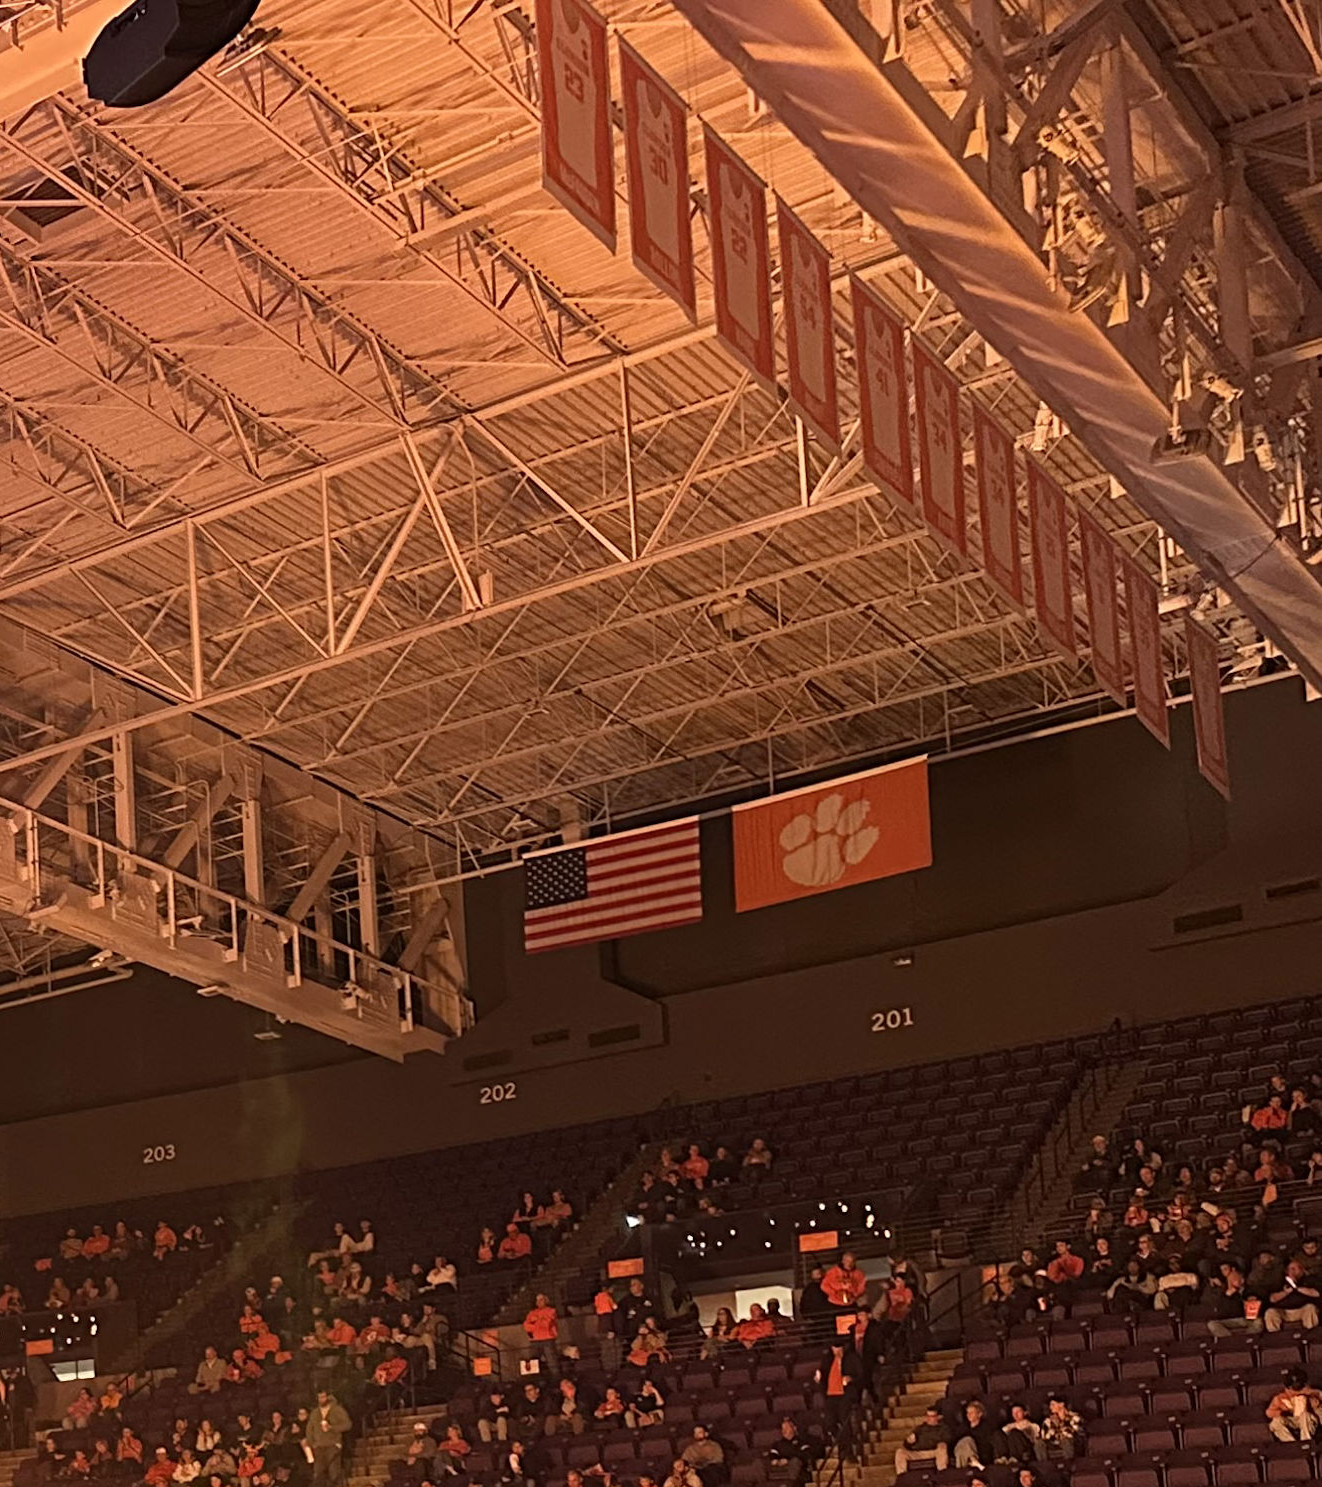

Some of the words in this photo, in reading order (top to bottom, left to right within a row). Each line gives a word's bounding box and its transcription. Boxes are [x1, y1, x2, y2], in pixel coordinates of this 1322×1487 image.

[871, 1007, 914, 1032] 201
[479, 1082, 516, 1104] 202
[143, 1144, 176, 1164] 203
